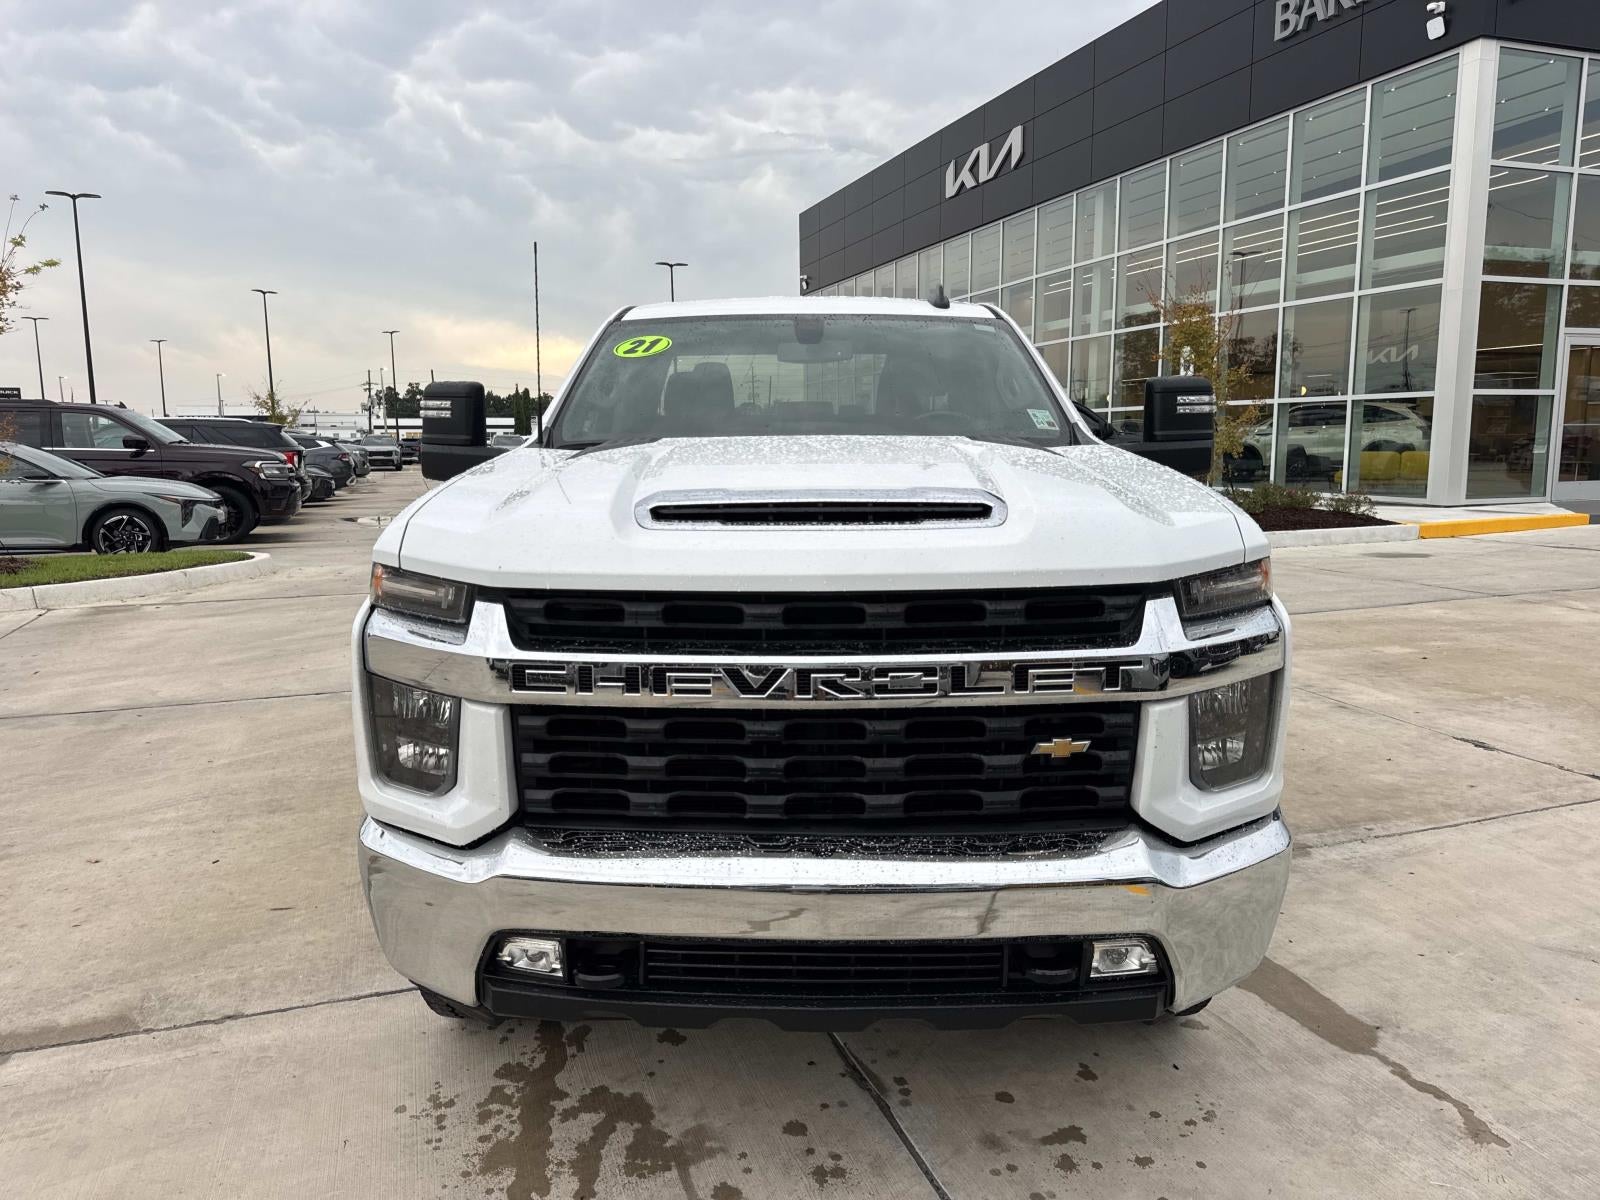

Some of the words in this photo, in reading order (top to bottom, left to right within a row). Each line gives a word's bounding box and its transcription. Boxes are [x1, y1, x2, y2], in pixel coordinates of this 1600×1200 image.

[1274, 0, 1367, 41] BA
[945, 125, 1024, 199] KIA
[623, 338, 663, 354] 21
[511, 660, 1144, 698] CHEVROLET
